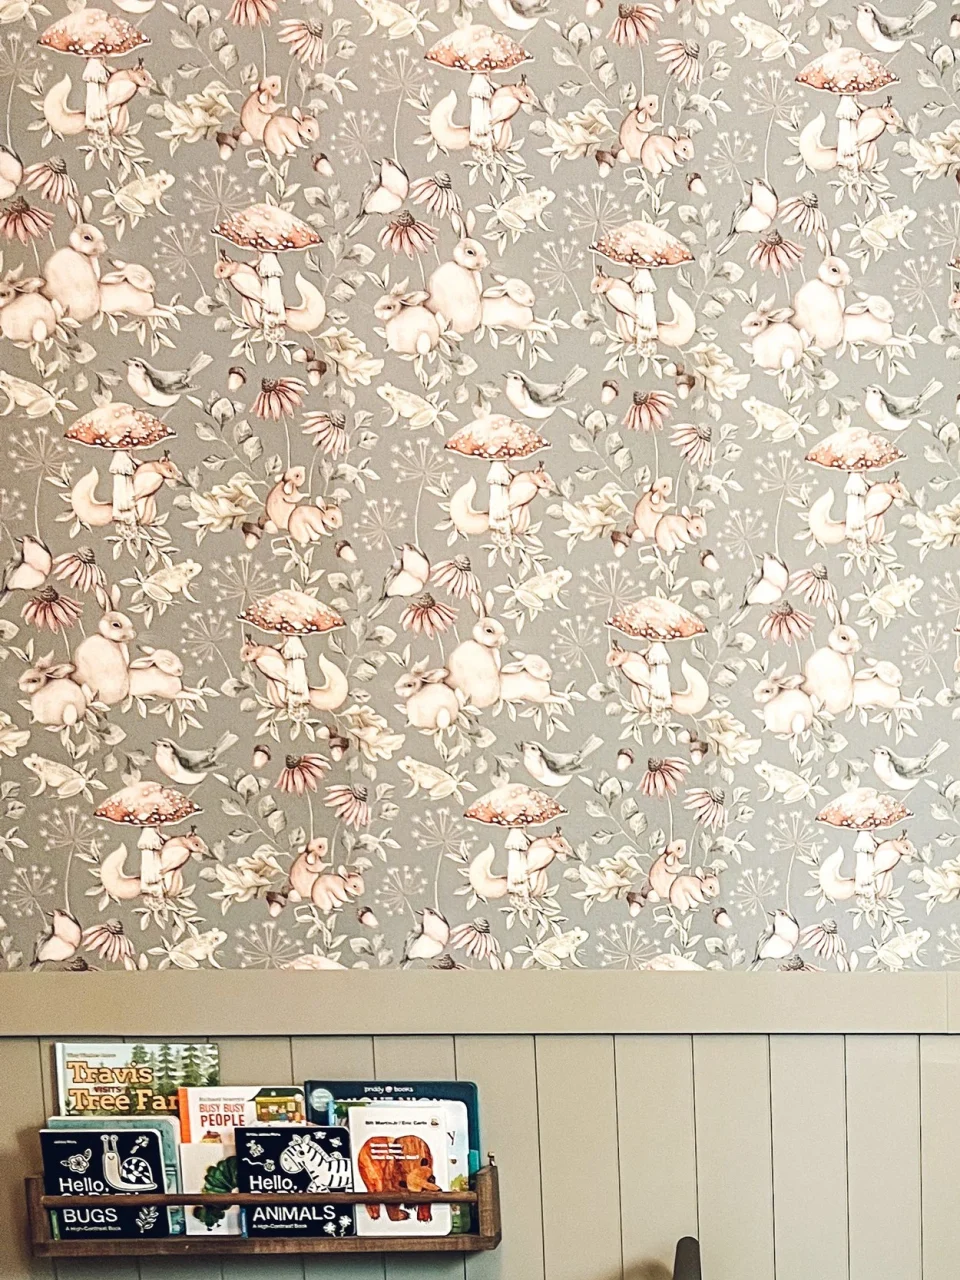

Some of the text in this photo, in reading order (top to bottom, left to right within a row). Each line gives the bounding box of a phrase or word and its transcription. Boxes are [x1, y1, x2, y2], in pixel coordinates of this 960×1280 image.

[67, 1061, 154, 1083] Travis
[68, 1088, 179, 1111] Tree Far
[199, 1103, 245, 1113] BUSY BUSY
[200, 1113, 246, 1127] PEOPLE
[59, 1177, 109, 1193] Hello,
[249, 1174, 298, 1190] Hello,
[63, 1207, 118, 1223] BUGS
[253, 1205, 337, 1221] ANIMALS
